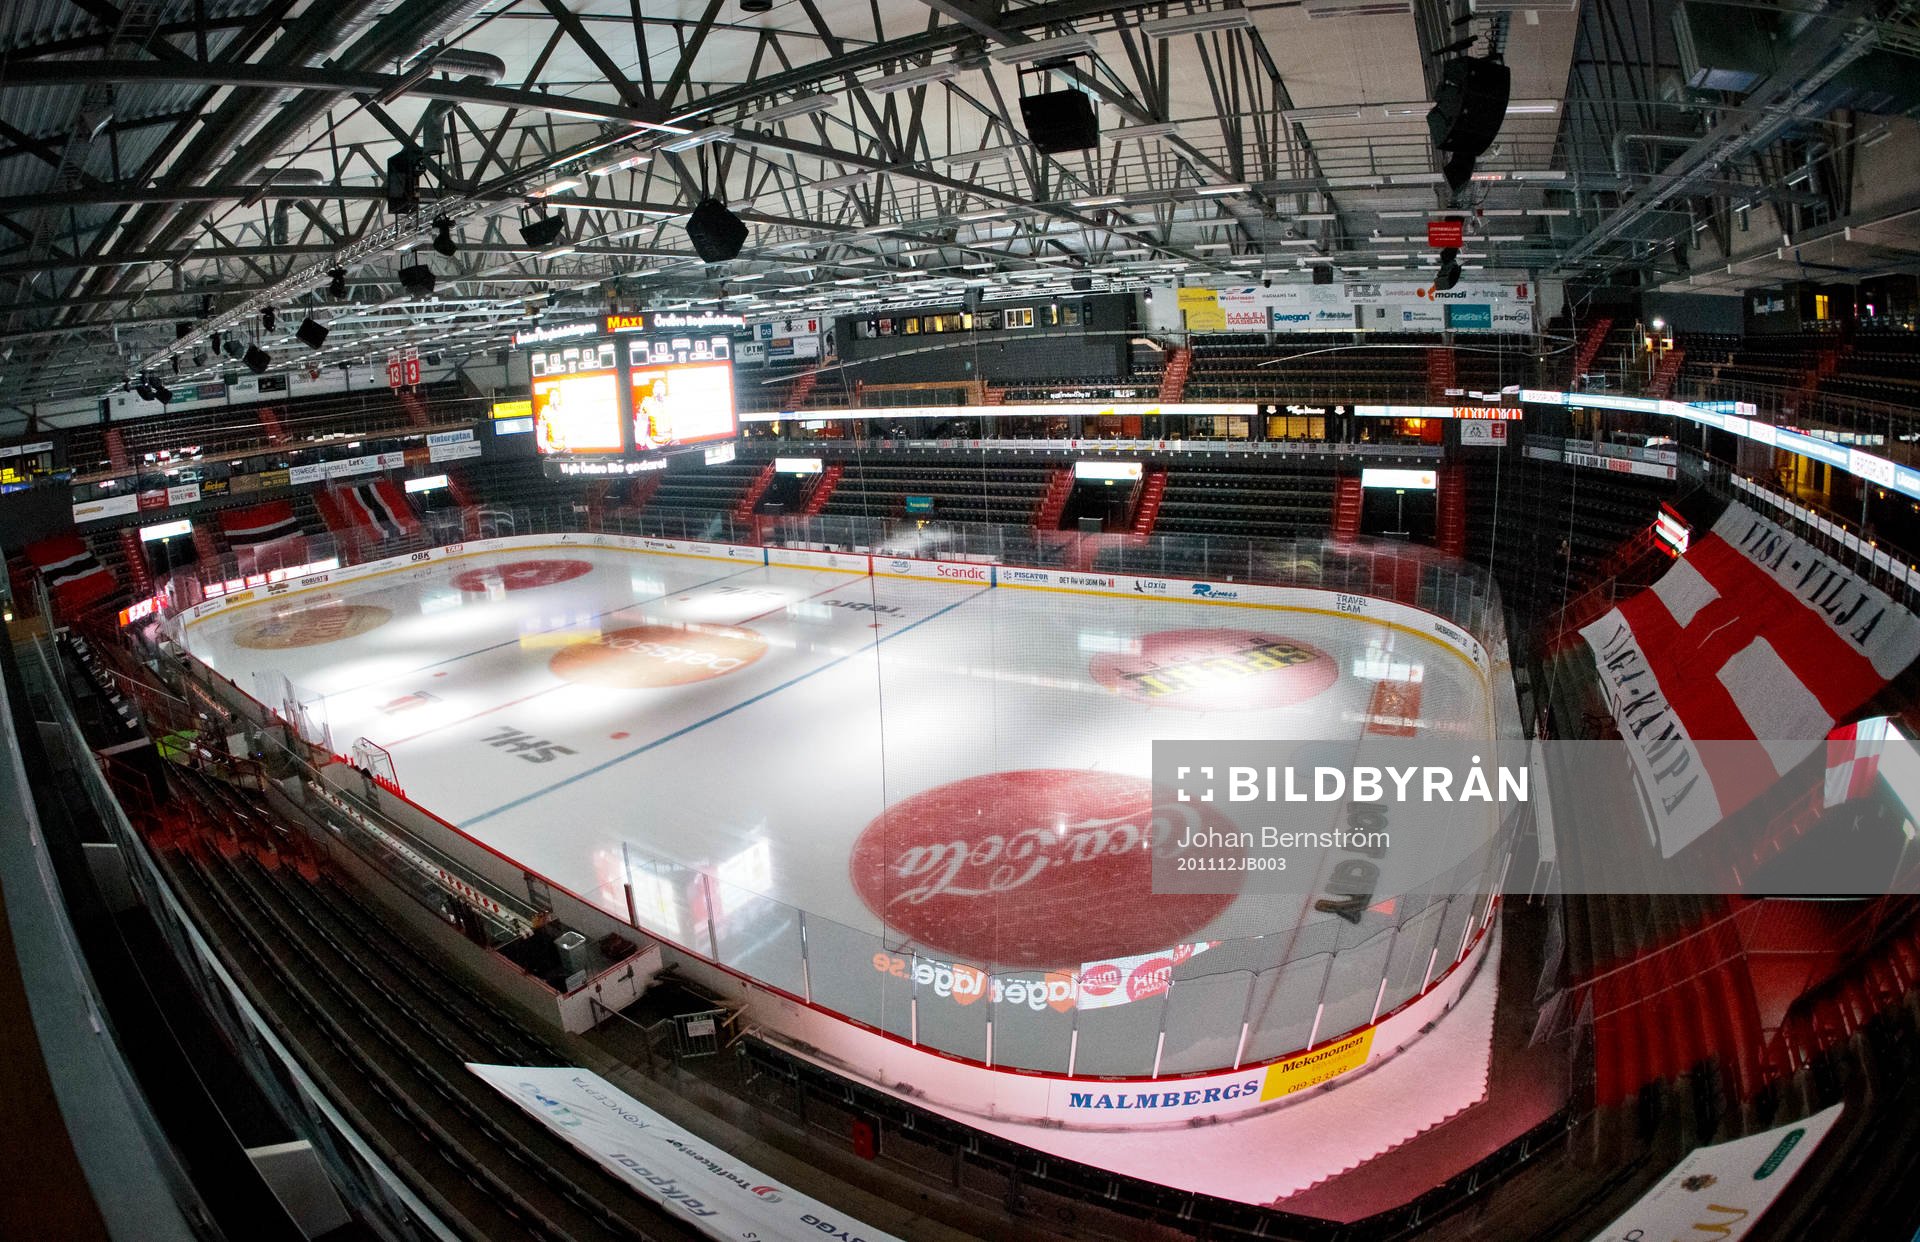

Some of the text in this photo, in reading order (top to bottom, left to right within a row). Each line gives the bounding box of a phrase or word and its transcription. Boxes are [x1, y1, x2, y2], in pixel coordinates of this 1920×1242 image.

[1435, 290, 1467, 298] mondi
[607, 316, 643, 328] MAXI
[1274, 313, 1310, 323] Swegon
[429, 432, 471, 444] Vintergatan
[411, 551, 430, 561] OBK
[937, 564, 985, 580] Scandic
[1014, 571, 1049, 581] PISCATOR
[1143, 580, 1167, 590] Loxia
[1336, 594, 1368, 607] TRAVEL
[1336, 602, 1361, 613] TEAM
[480, 726, 580, 763] SHL
[888, 798, 1206, 906] Coca-Cola
[1281, 1036, 1364, 1074] Mekonomen
[1069, 1079, 1259, 1110] MALMBERGS
[665, 1137, 752, 1191] Trafikcenter
